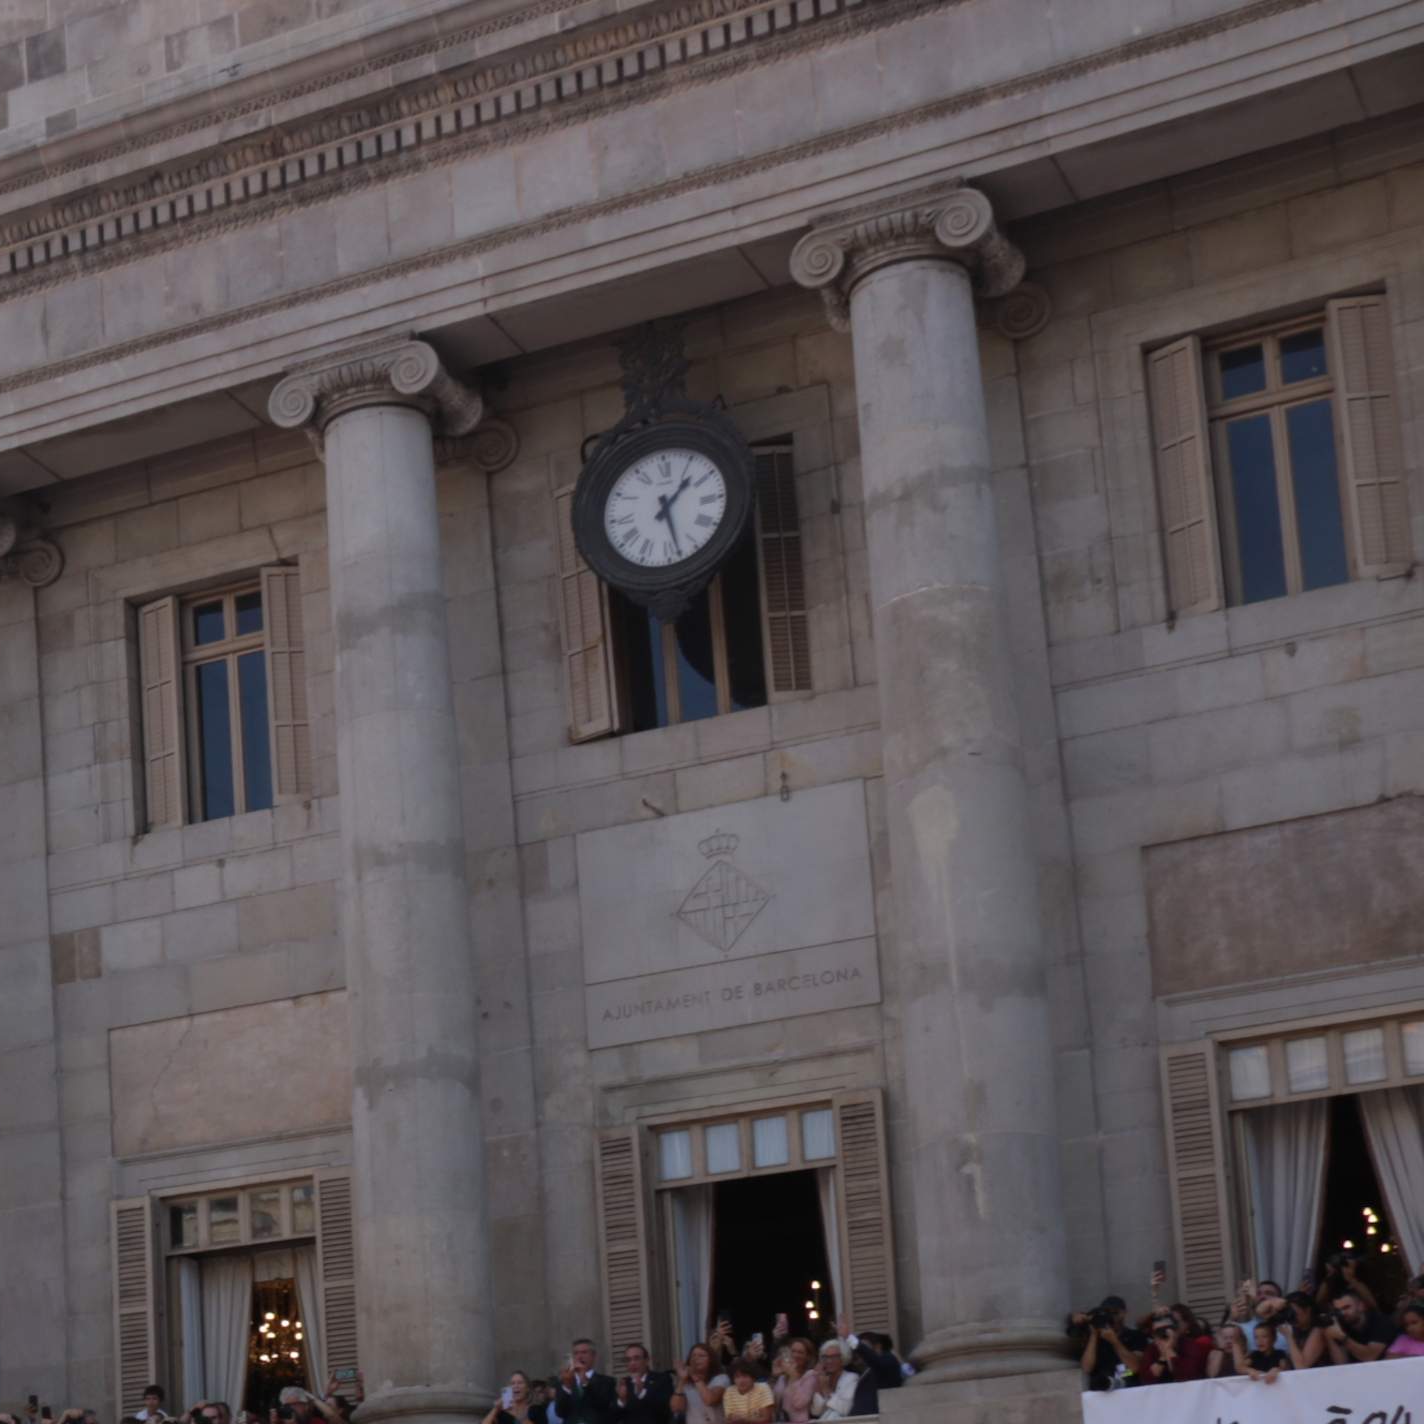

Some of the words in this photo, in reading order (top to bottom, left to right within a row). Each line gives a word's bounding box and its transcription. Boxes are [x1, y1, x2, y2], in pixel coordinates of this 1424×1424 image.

[602, 990, 711, 1022] AJUNTAMENT
[720, 985, 744, 1002] DE
[753, 966, 863, 996] BARCELONA
